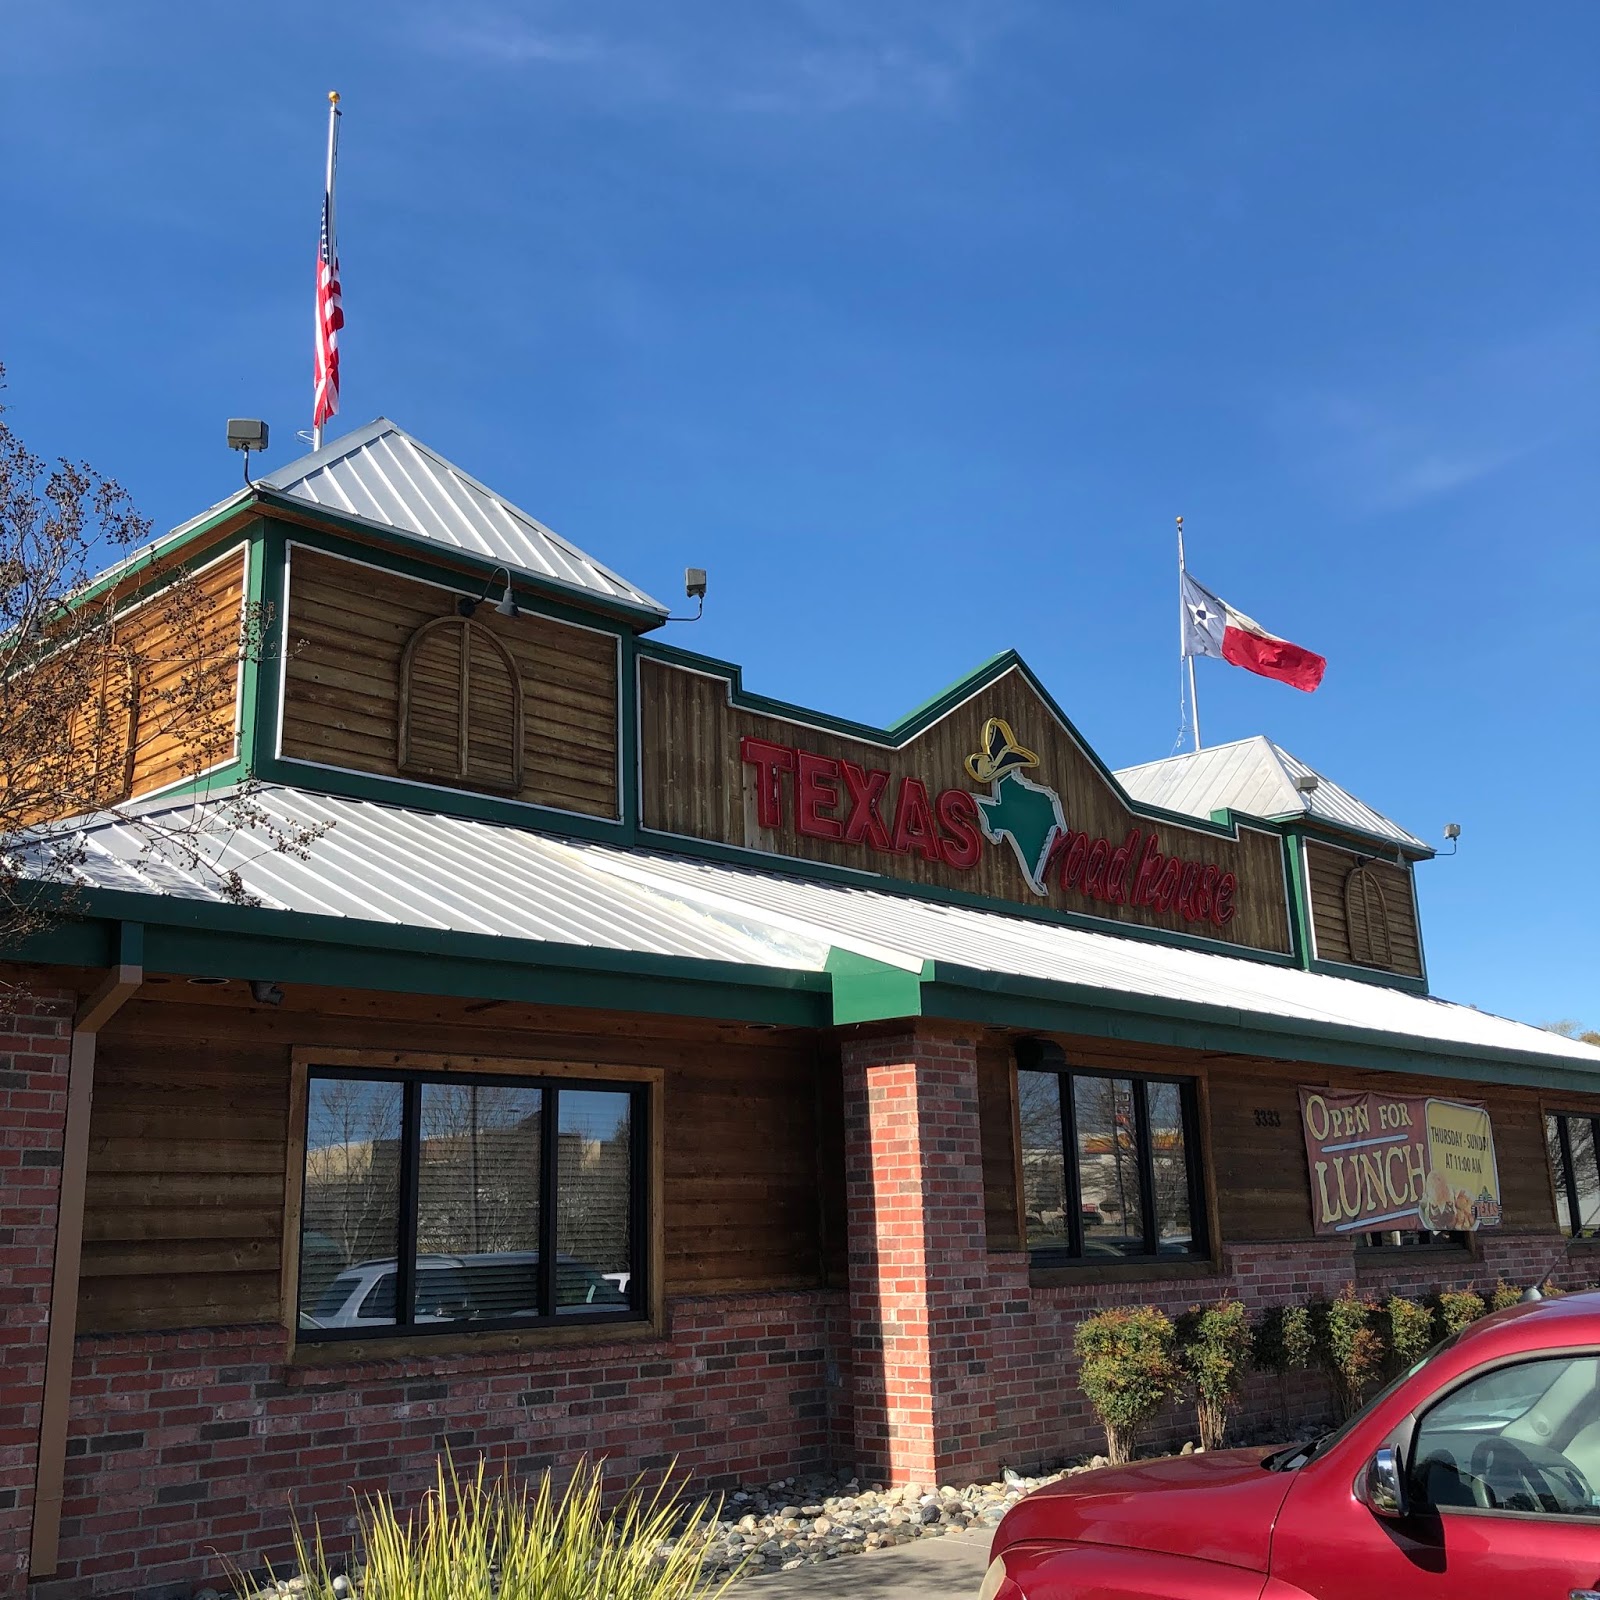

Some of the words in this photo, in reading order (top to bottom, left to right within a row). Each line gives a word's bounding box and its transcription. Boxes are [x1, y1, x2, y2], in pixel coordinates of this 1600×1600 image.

[740, 736, 984, 870] TEXAS
[1254, 1109, 1281, 1127] 3333
[1378, 1102, 1413, 1130] FOR
[1431, 1126, 1462, 1147] THURSDAY
[1446, 1152, 1453, 1169] AT
[1471, 1157, 1482, 1174] AM
[1315, 1143, 1427, 1223] LUNCH
